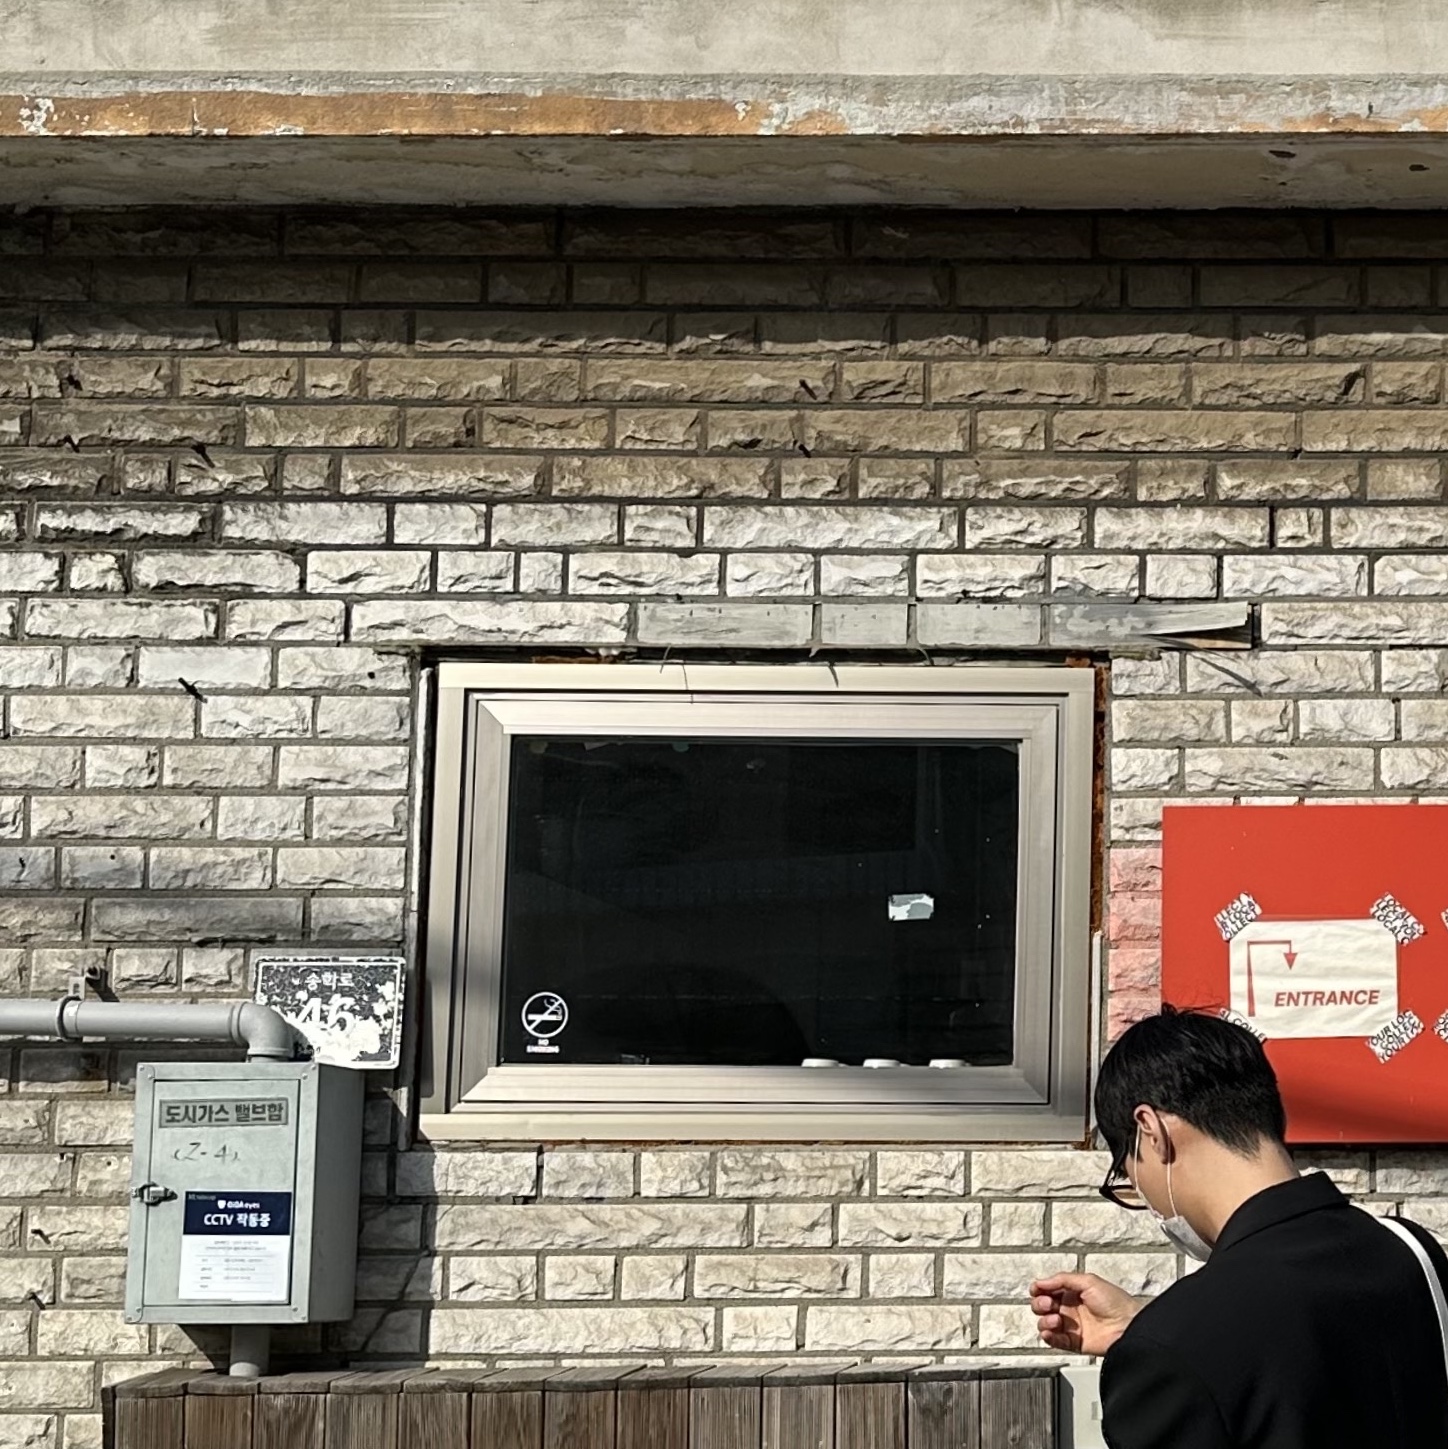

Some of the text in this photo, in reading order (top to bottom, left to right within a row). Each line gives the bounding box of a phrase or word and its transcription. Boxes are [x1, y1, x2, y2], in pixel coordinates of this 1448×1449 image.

[1274, 989, 1380, 1007] ENTRANCE
[165, 1102, 284, 1123] 도시가스 밸브함
[204, 1213, 271, 1227] CCTV 작동중
